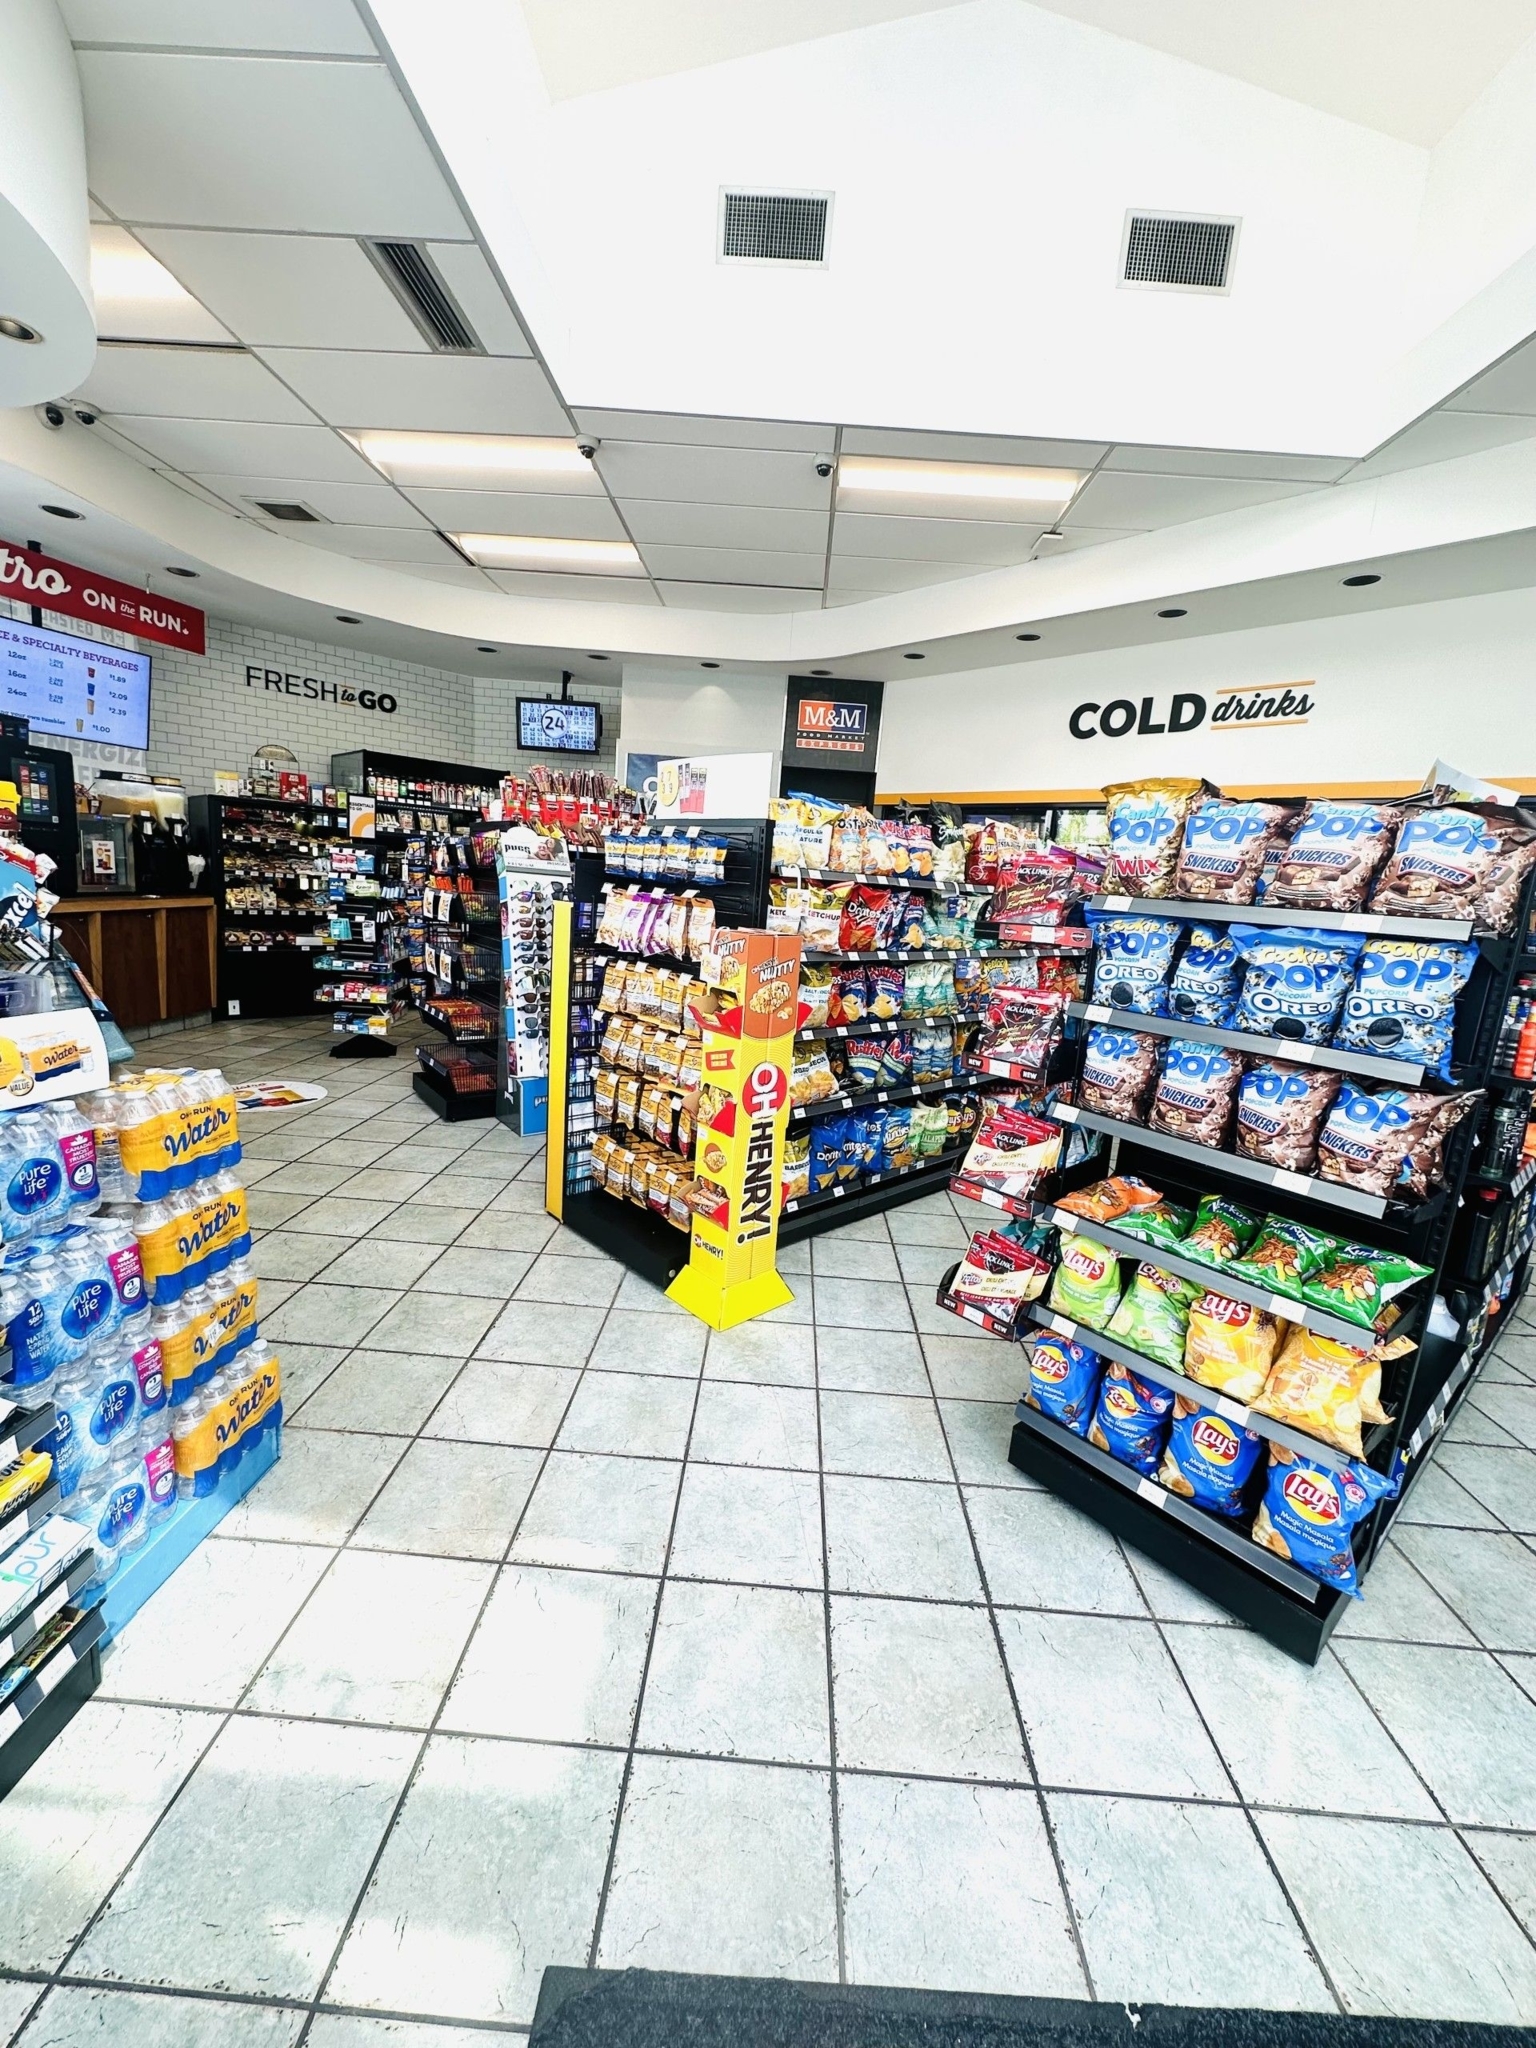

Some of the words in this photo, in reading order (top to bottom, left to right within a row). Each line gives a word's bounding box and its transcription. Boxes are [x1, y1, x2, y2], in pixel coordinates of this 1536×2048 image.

[83, 588, 116, 613] ON
[120, 602, 136, 616] the
[8, 650, 27, 661] 12oz
[22, 636, 81, 658] SPECIALTY
[83, 651, 139, 673] BEVERAGES
[246, 665, 338, 704] FRESH
[340, 690, 357, 703] to
[358, 690, 397, 714] GO
[545, 716, 565, 731] 24
[803, 706, 861, 729] M&M
[1069, 693, 1207, 740] COLD
[1211, 689, 1315, 723] drinks
[1116, 802, 1167, 820] Candy
[1110, 816, 1175, 846] POP
[1185, 815, 1266, 849] POP
[1293, 813, 1383, 845] POP
[1112, 855, 1162, 877] TWIX
[1184, 854, 1239, 874] SNICKERS
[1288, 849, 1352, 866] SNICKERS
[1400, 856, 1467, 884] SNICKERS
[1111, 919, 1161, 933] Cookie
[1105, 931, 1169, 961] POP
[1261, 946, 1328, 965] Cookie
[1369, 939, 1441, 961] Cookie
[759, 959, 796, 983] NUTTY
[1098, 963, 1159, 982] OREO
[1356, 953, 1453, 993] POP
[1363, 987, 1410, 997] POPCORN
[1251, 992, 1333, 1016] OREO
[1348, 996, 1435, 1019] OREO
[43, 1044, 79, 1066] Water
[1171, 1038, 1224, 1056] Candy
[968, 1058, 982, 1067] NEW
[1161, 1050, 1231, 1083] POP
[1022, 1071, 1038, 1079] NEW
[10, 1082, 31, 1092] VALUE
[751, 1062, 779, 1121] OH
[1159, 1085, 1206, 1110] SNICKERS
[1238, 1107, 1280, 1133] SNICKERS
[164, 1107, 230, 1157] Water
[1320, 1129, 1374, 1160] SNICKERS
[19, 1164, 52, 1185] Pure
[737, 1120, 775, 1245] HENRY!
[24, 1177, 47, 1196] Life
[203, 1201, 222, 1214] RUN
[178, 1201, 241, 1257] Water
[702, 1241, 724, 1261] HENRY!
[72, 1284, 102, 1310] Pure
[943, 1297, 956, 1309] NEW
[28, 1302, 42, 1318] 12
[77, 1299, 99, 1319] Life
[993, 1322, 1008, 1334] NEW
[240, 1378, 258, 1393] RUN
[100, 1385, 127, 1416] Pure
[104, 1399, 124, 1423] Life
[216, 1374, 277, 1443] Water
[1274, 1514, 1301, 1536] Masala
[1302, 1531, 1337, 1553] magique
[1280, 1510, 1303, 1529] Magic
[1303, 1523, 1334, 1543] Masala
